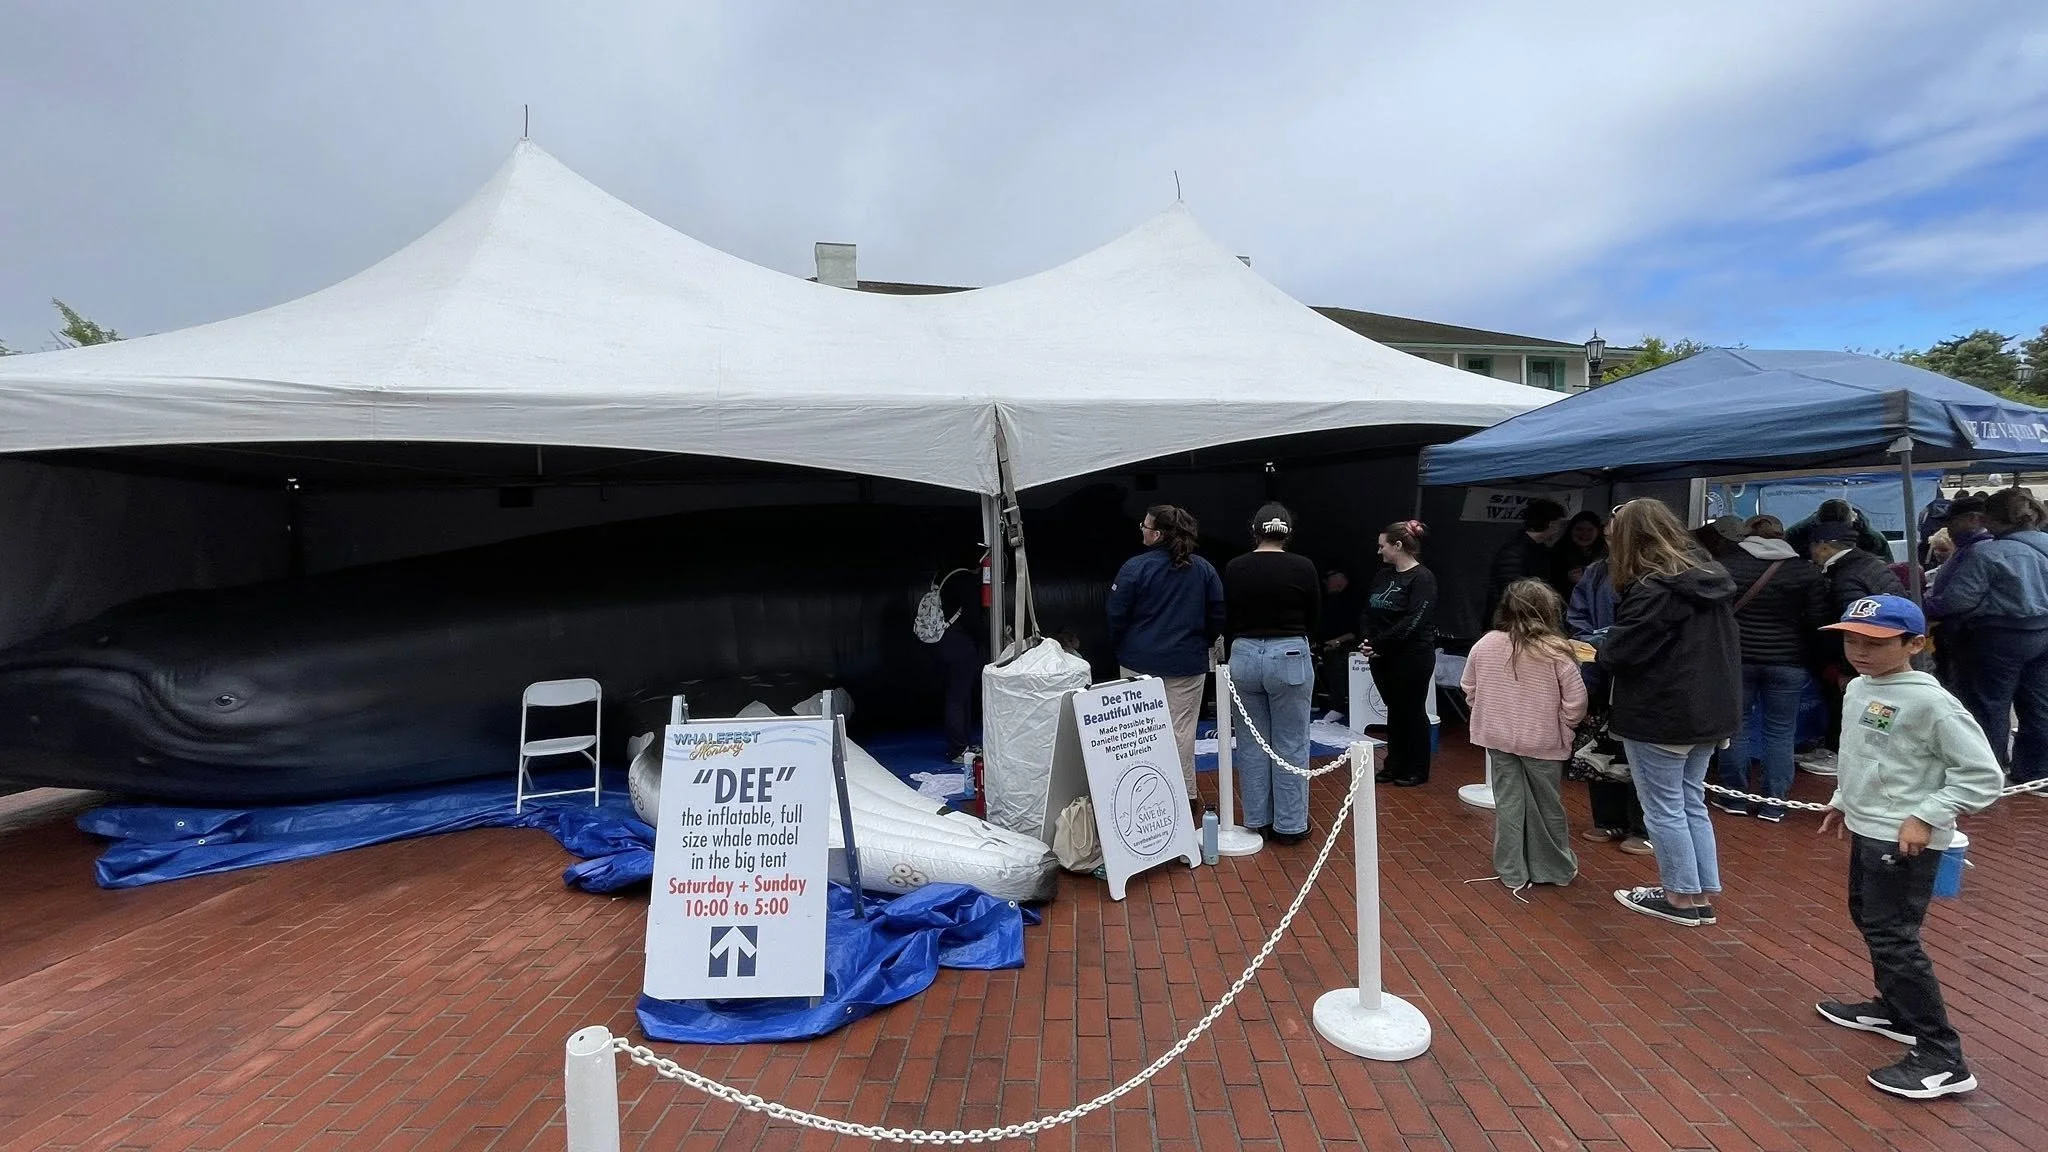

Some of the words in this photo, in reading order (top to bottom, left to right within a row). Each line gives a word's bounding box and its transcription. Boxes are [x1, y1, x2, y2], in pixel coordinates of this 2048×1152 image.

[1101, 694, 1122, 707] Dee
[1123, 689, 1142, 702] The
[1083, 704, 1132, 726] Beautiful
[1132, 698, 1164, 714] Whale
[1099, 726, 1118, 736] Made
[1118, 719, 1146, 730] Possible
[1146, 716, 1156, 725] by:
[674, 730, 761, 746] WHALEFEST
[1090, 735, 1120, 748] Danielle
[1120, 730, 1138, 742] (Dee)
[1105, 740, 1137, 754] Monterey
[1138, 734, 1158, 745] GIVES
[689, 742, 744, 760] Monterey
[1115, 752, 1128, 760] Eva
[682, 808, 702, 826] the
[706, 805, 776, 828] inflatable,
[780, 804, 803, 824] full
[1138, 810, 1156, 824] SAVE
[1156, 806, 1167, 817] the
[1141, 816, 1173, 834] WHALES
[682, 829, 708, 848] size
[712, 827, 752, 848] whale
[756, 826, 798, 846] model
[691, 852, 704, 870] in
[708, 850, 730, 869] the
[734, 850, 755, 873] big
[760, 851, 788, 868] tent
[668, 876, 734, 898] Saturday
[738, 882, 750, 893] +
[754, 873, 808, 896] Sunday
[685, 899, 728, 918] 10:00
[734, 899, 748, 916] to
[754, 897, 790, 916] 5:00
